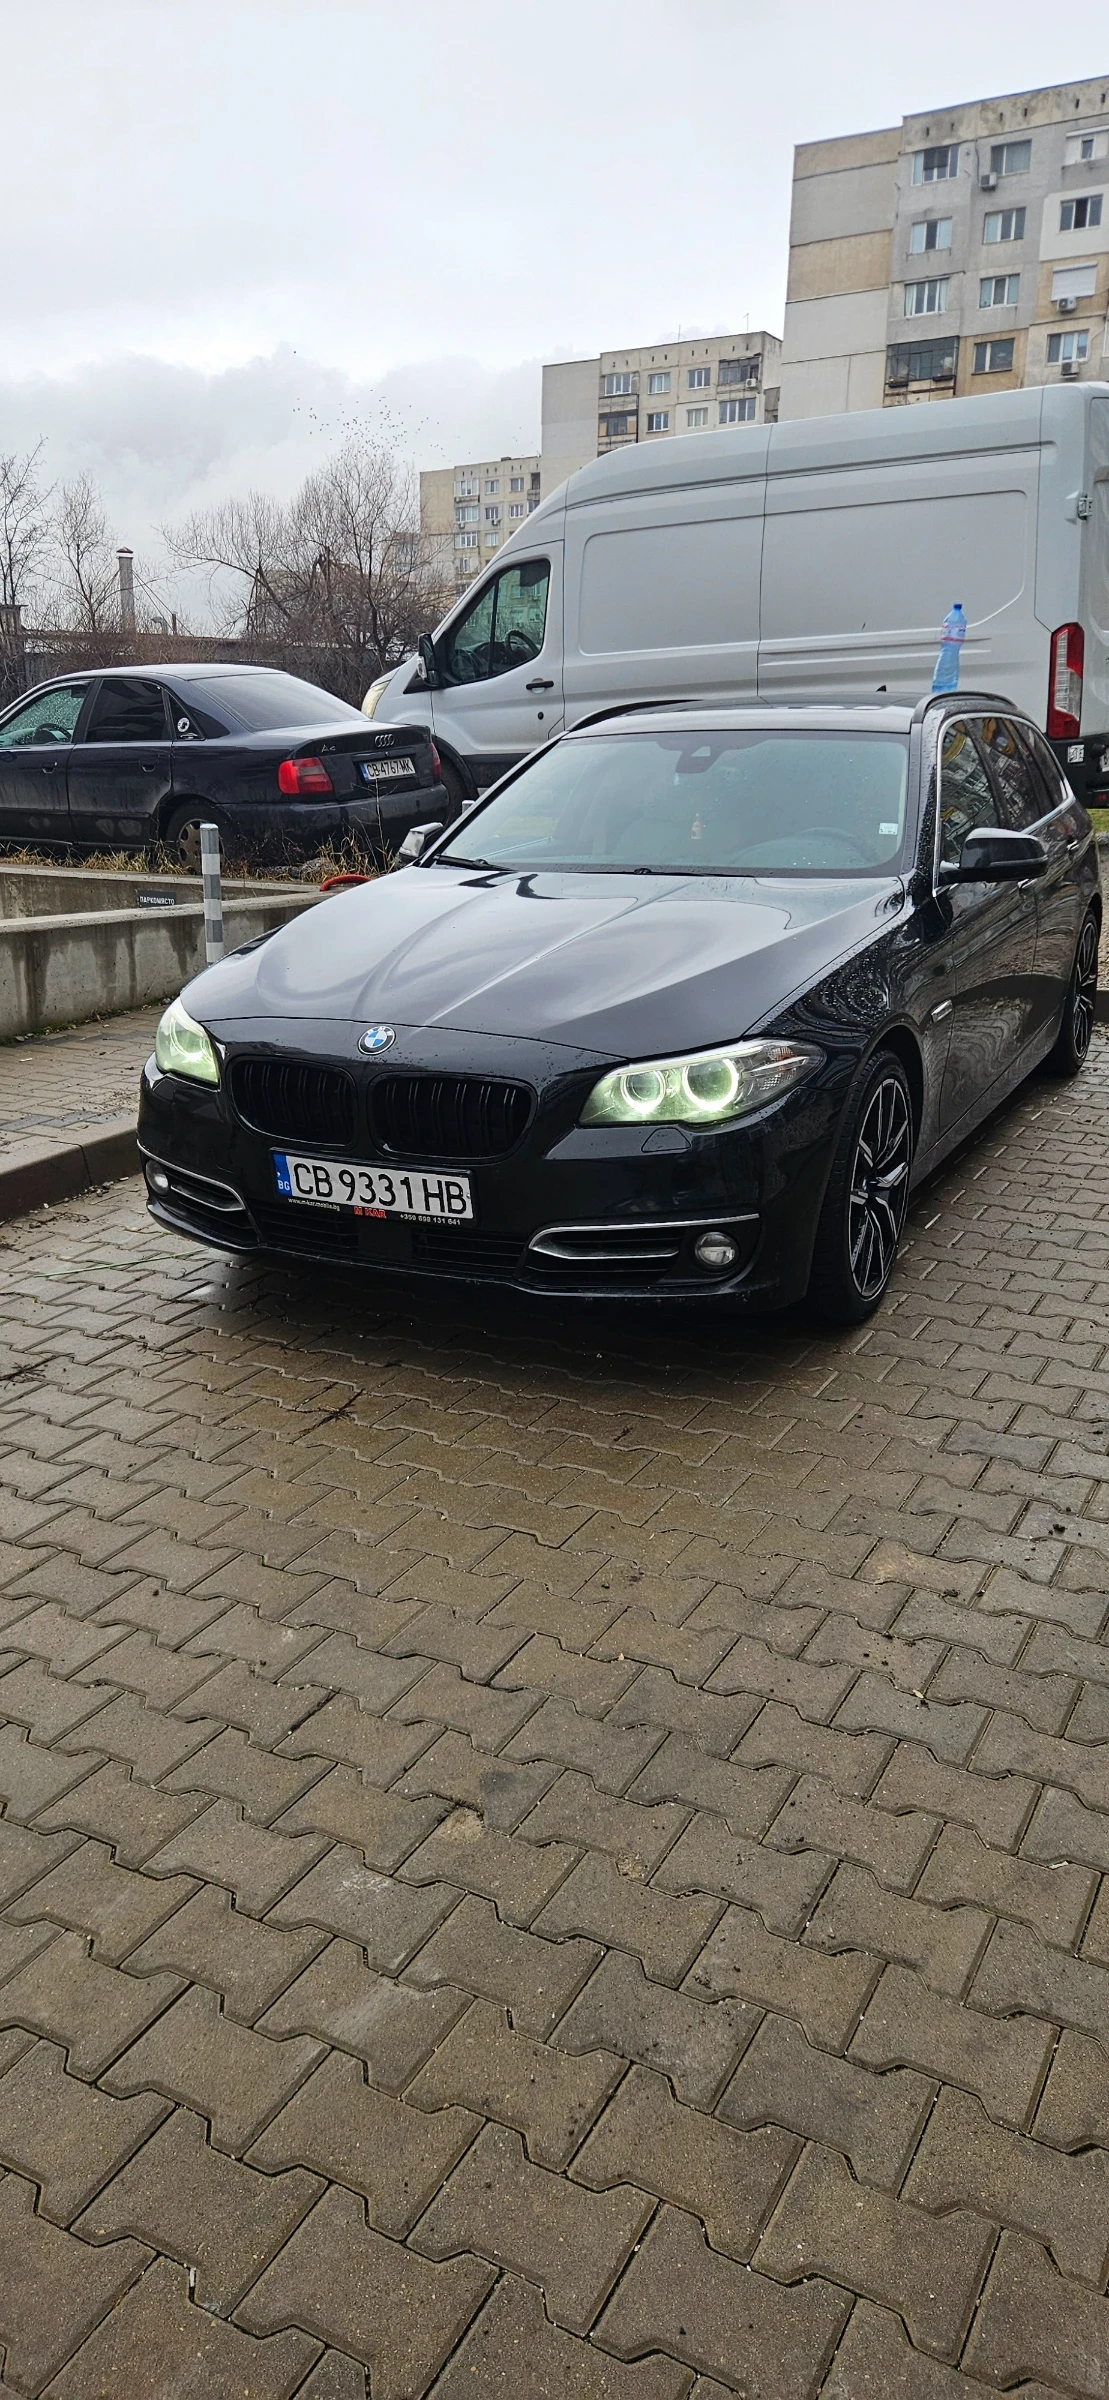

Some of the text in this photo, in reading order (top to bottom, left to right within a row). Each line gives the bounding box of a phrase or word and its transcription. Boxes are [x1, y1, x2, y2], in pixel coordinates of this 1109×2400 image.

[277, 1179, 290, 1191] BG
[293, 1163, 467, 1215] CB 9331 HB
[364, 1207, 387, 1219] KAR
